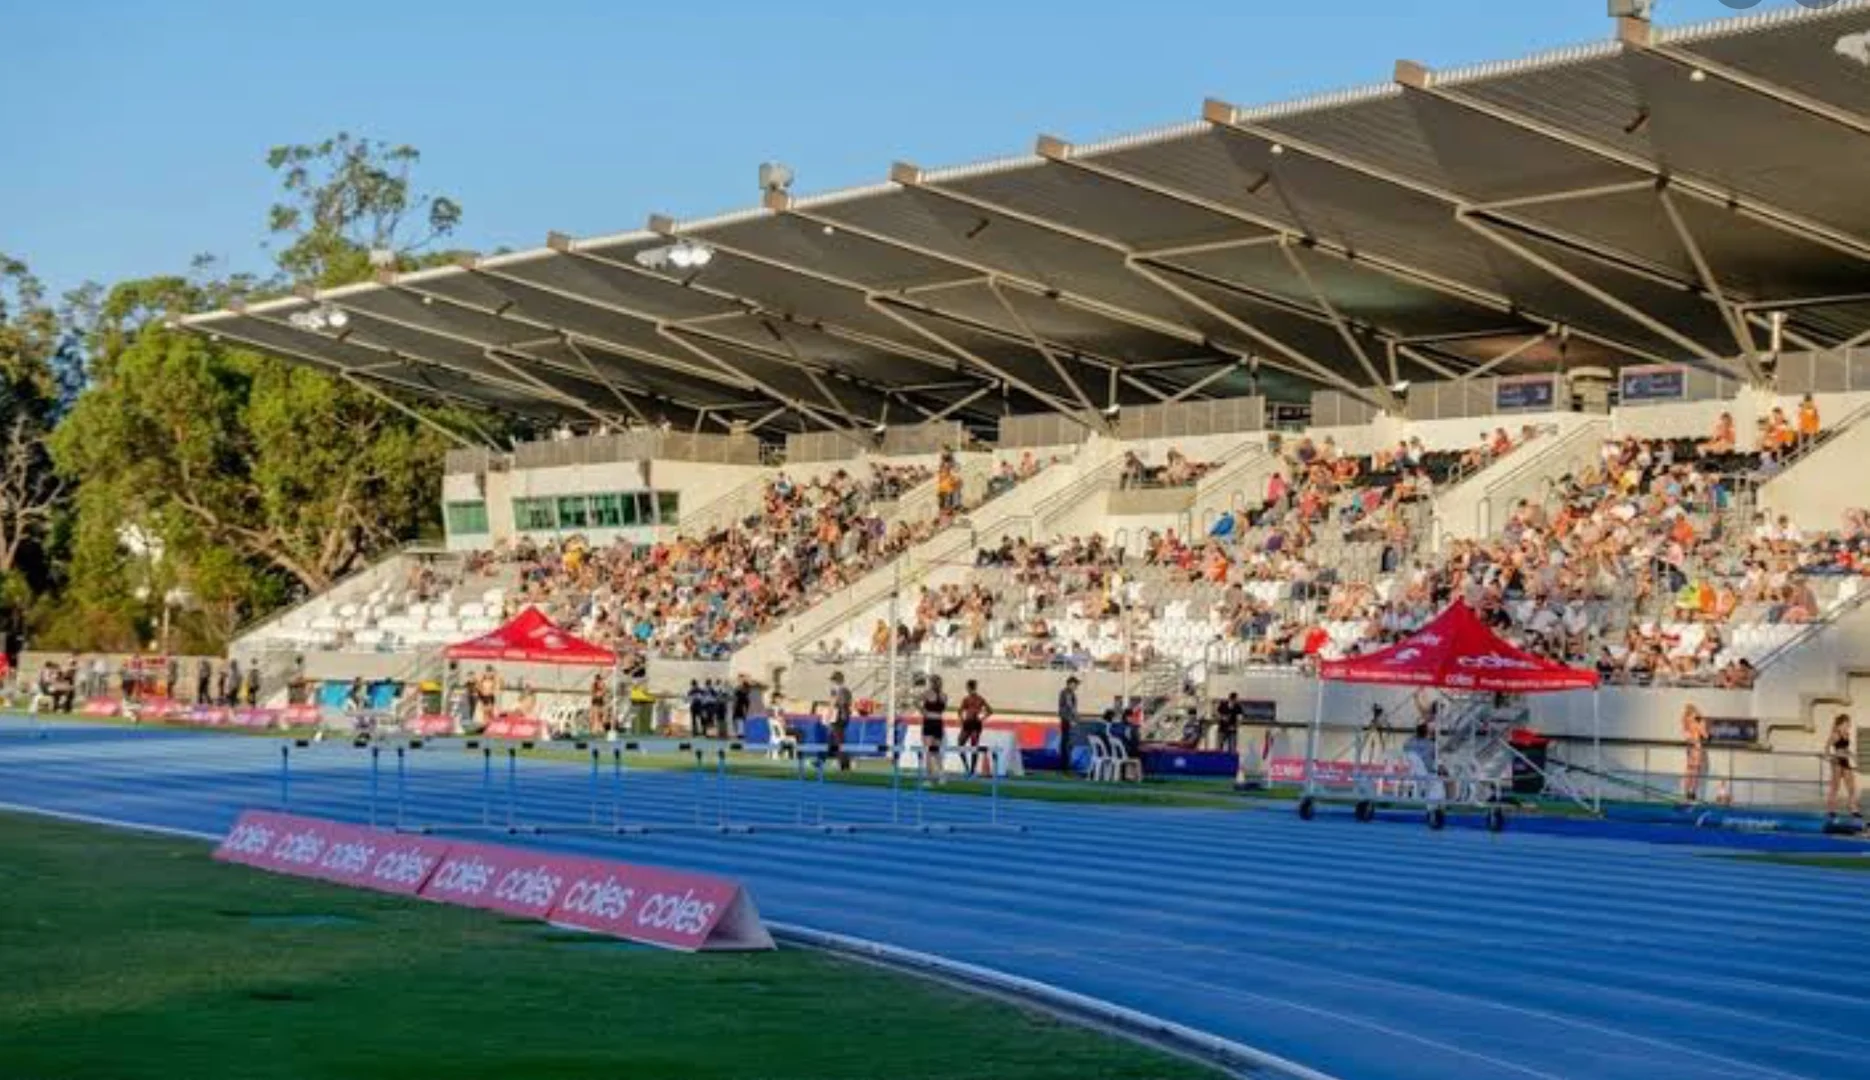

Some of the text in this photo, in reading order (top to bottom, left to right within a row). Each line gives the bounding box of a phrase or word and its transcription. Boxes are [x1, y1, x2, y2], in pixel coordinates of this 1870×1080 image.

[373, 846, 432, 884] coles
[433, 855, 716, 935] coles coles coles coles
